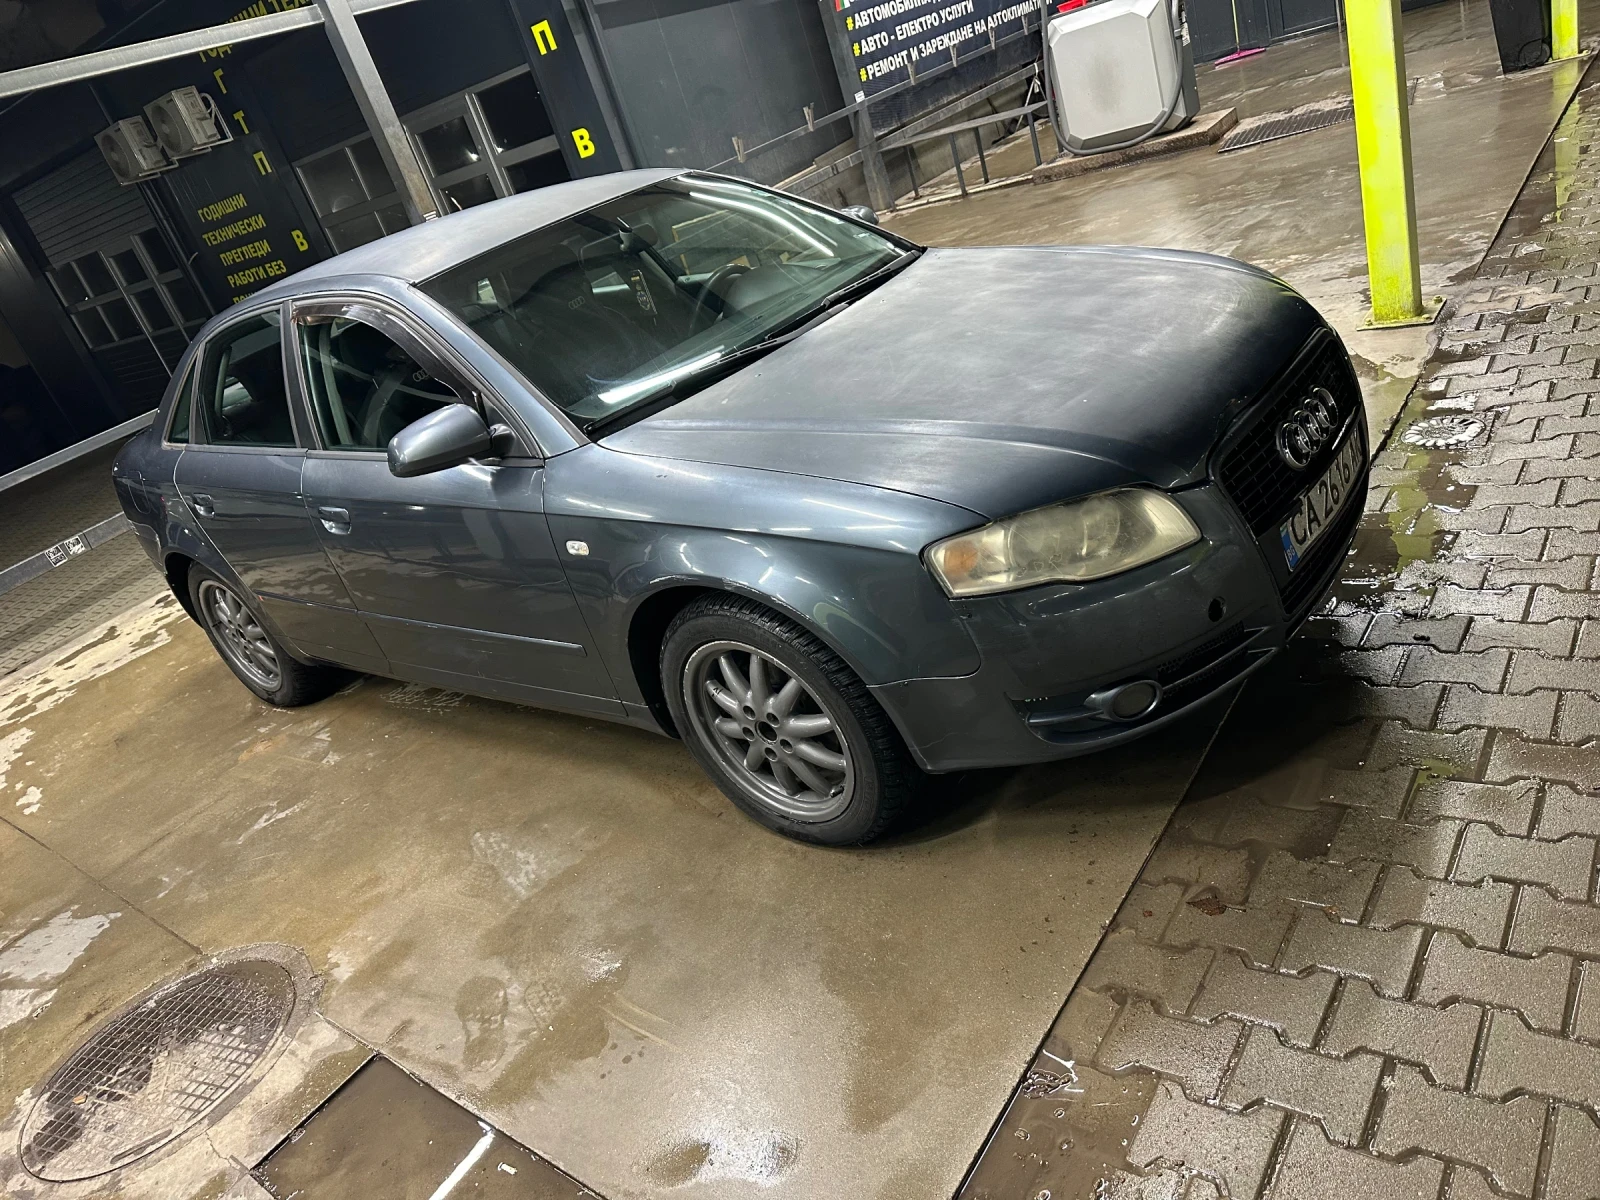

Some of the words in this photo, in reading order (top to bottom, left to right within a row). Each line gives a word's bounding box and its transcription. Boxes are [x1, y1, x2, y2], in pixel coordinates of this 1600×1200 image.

[895, 12, 940, 41] ЕЛЕКТРО
[939, 0, 974, 24] УСЛУГИ
[909, 46, 919, 62] И
[919, 24, 974, 57] ЗАРЕЖДАНЕ
[974, 18, 987, 35] НА
[987, 0, 1052, 30] АВТОКЛИМАТИИ
[197, 193, 247, 223] ГОДИШНИ
[202, 213, 267, 247] ТЕХНИЧЕСКИ
[219, 239, 272, 267] ПРЕГЛЕДИ
[227, 266, 267, 288] РАБОТИ
[265, 260, 287, 277] БЕЗ
